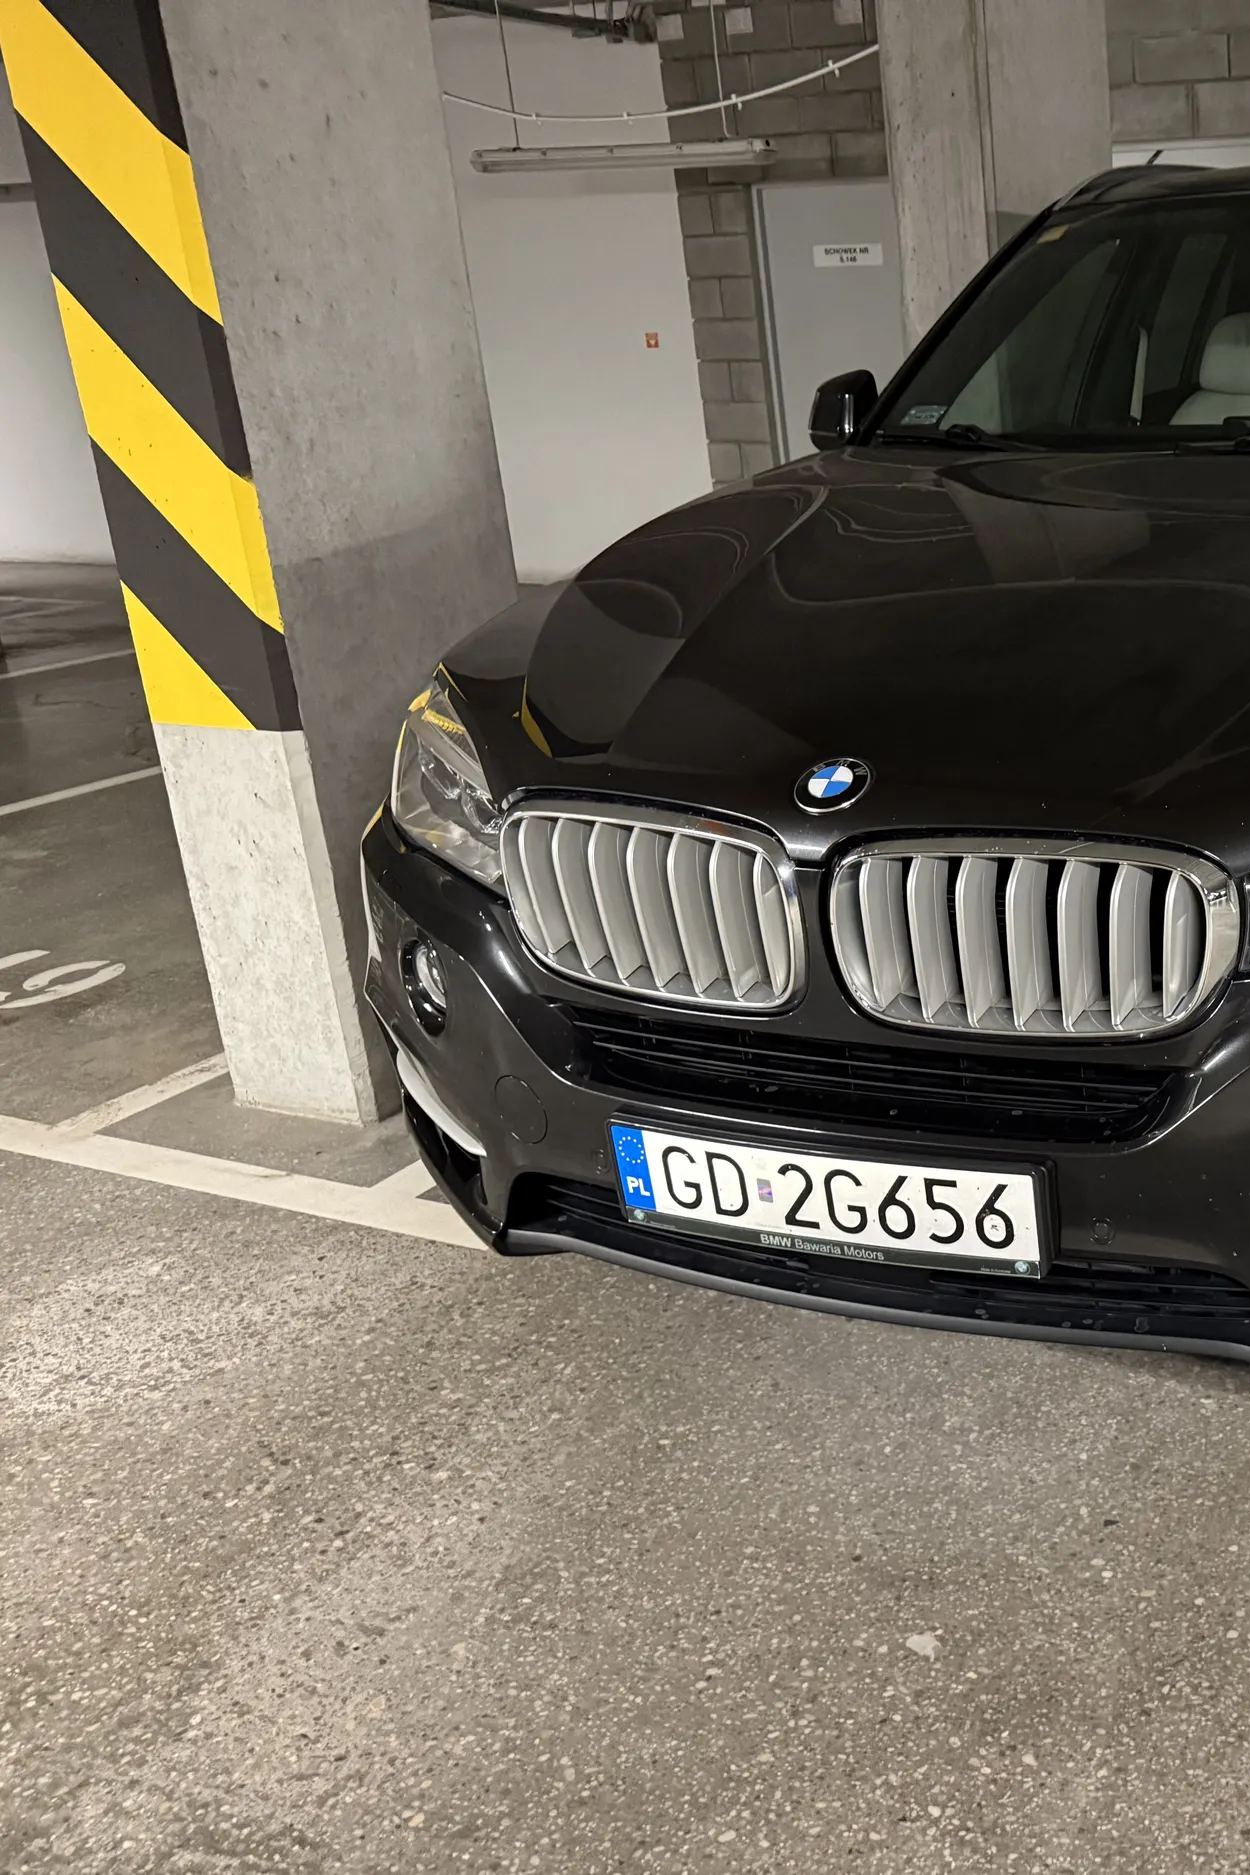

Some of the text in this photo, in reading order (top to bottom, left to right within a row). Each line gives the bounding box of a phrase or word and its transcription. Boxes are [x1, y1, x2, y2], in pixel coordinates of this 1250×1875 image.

[626, 1175, 651, 1197] PL
[661, 1145, 1015, 1249] GD 2G656
[760, 1233, 885, 1261] BMW Bawaria Motors
